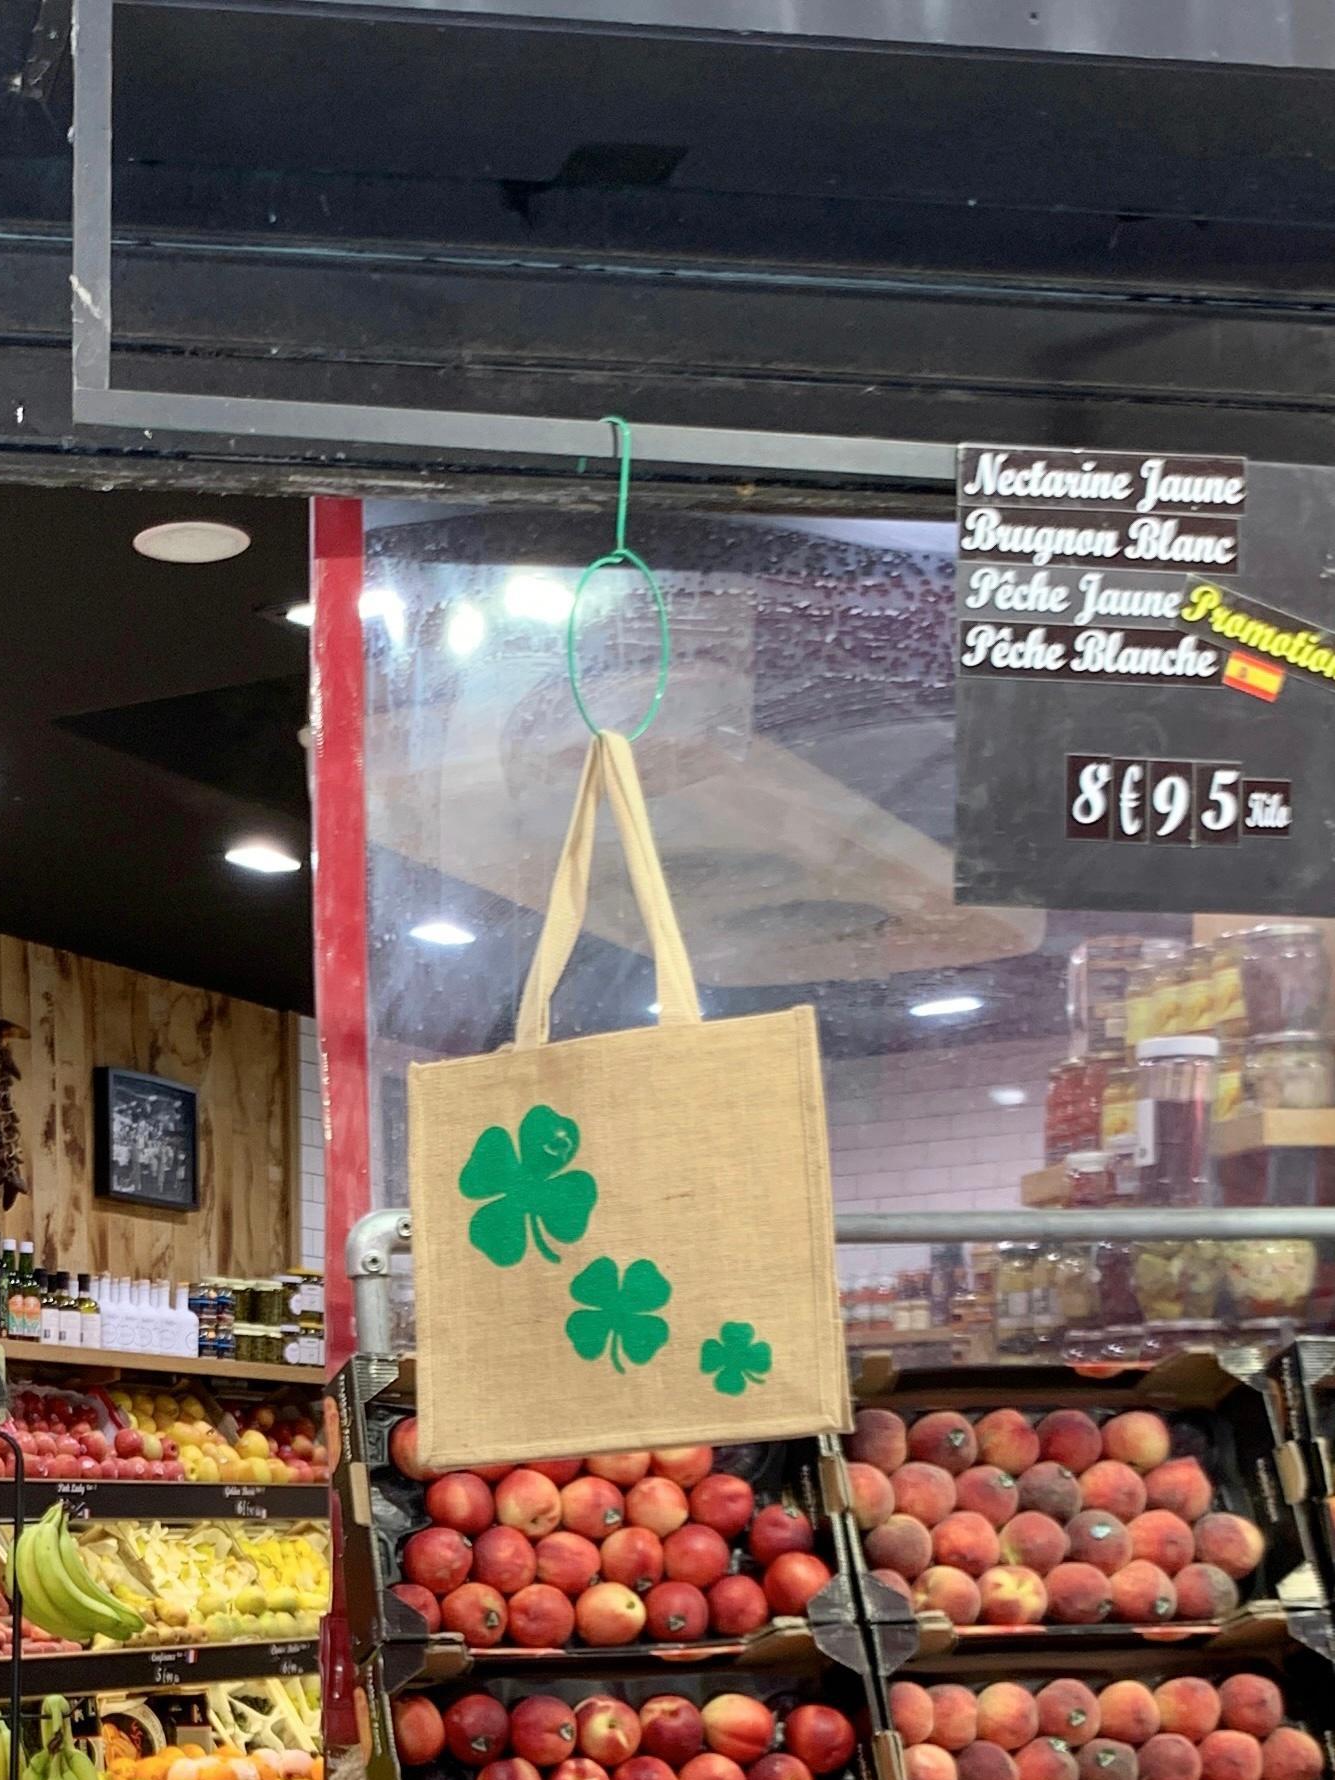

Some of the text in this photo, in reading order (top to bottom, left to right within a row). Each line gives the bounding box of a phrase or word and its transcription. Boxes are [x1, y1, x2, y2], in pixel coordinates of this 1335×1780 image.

[963, 451, 1248, 514] Nectarine Jaune
[961, 507, 1237, 567] Brugnon Blanc
[965, 566, 1182, 626] Pêche Jaune
[961, 623, 1219, 678] Pêche Blanche
[1244, 791, 1293, 829] Kilo
